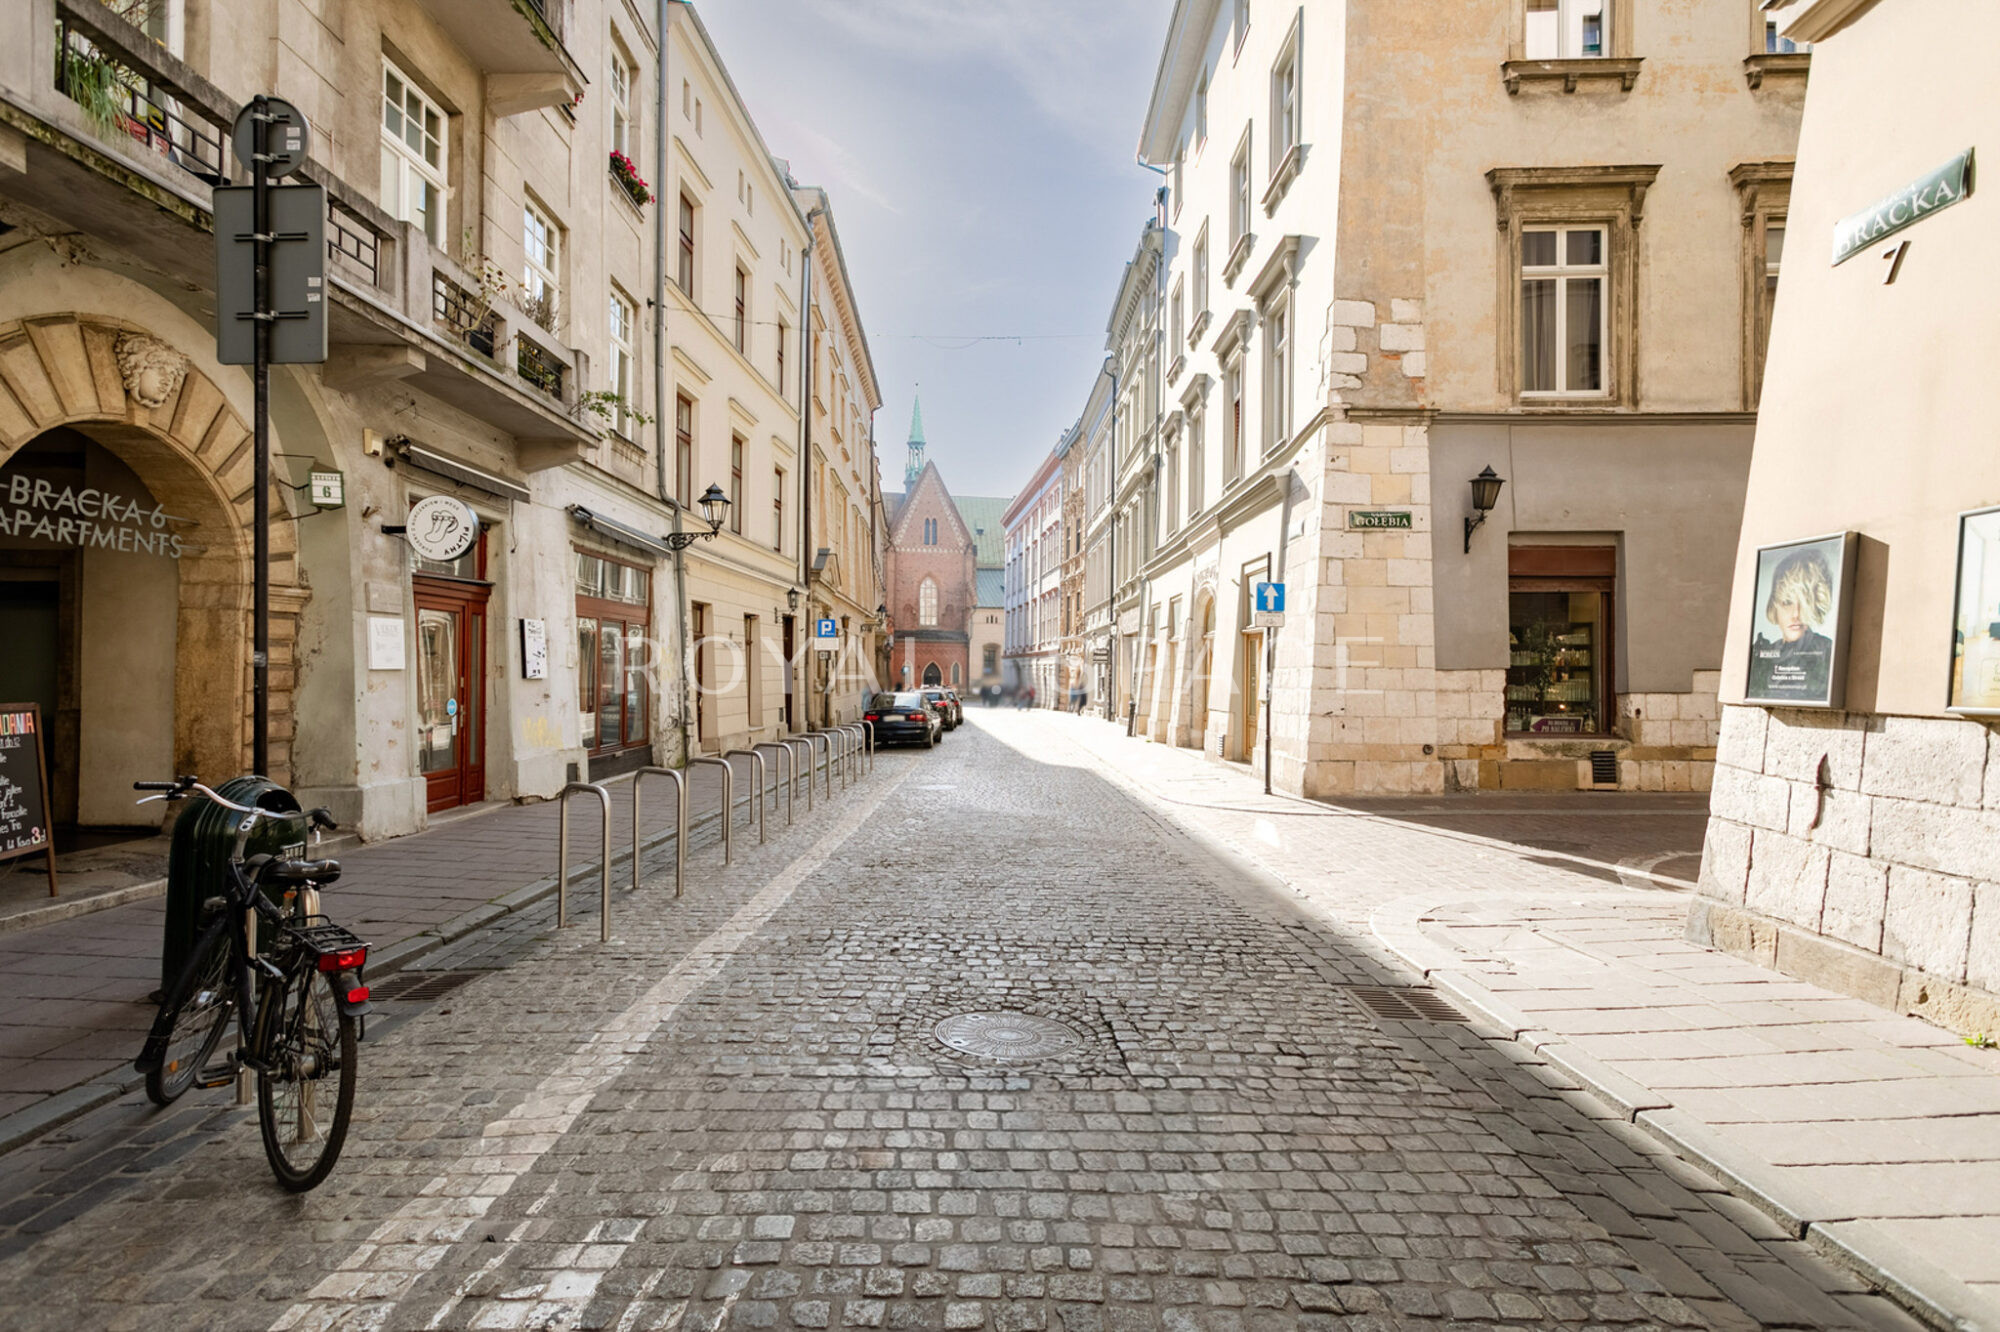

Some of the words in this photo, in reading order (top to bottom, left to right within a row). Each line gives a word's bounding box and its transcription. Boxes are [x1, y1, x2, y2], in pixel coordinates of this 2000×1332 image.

[1881, 239, 1912, 285] 7
[9, 474, 143, 526] BRACKA
[150, 503, 167, 529] 6
[322, 485, 332, 498] 6
[821, 620, 832, 636] P
